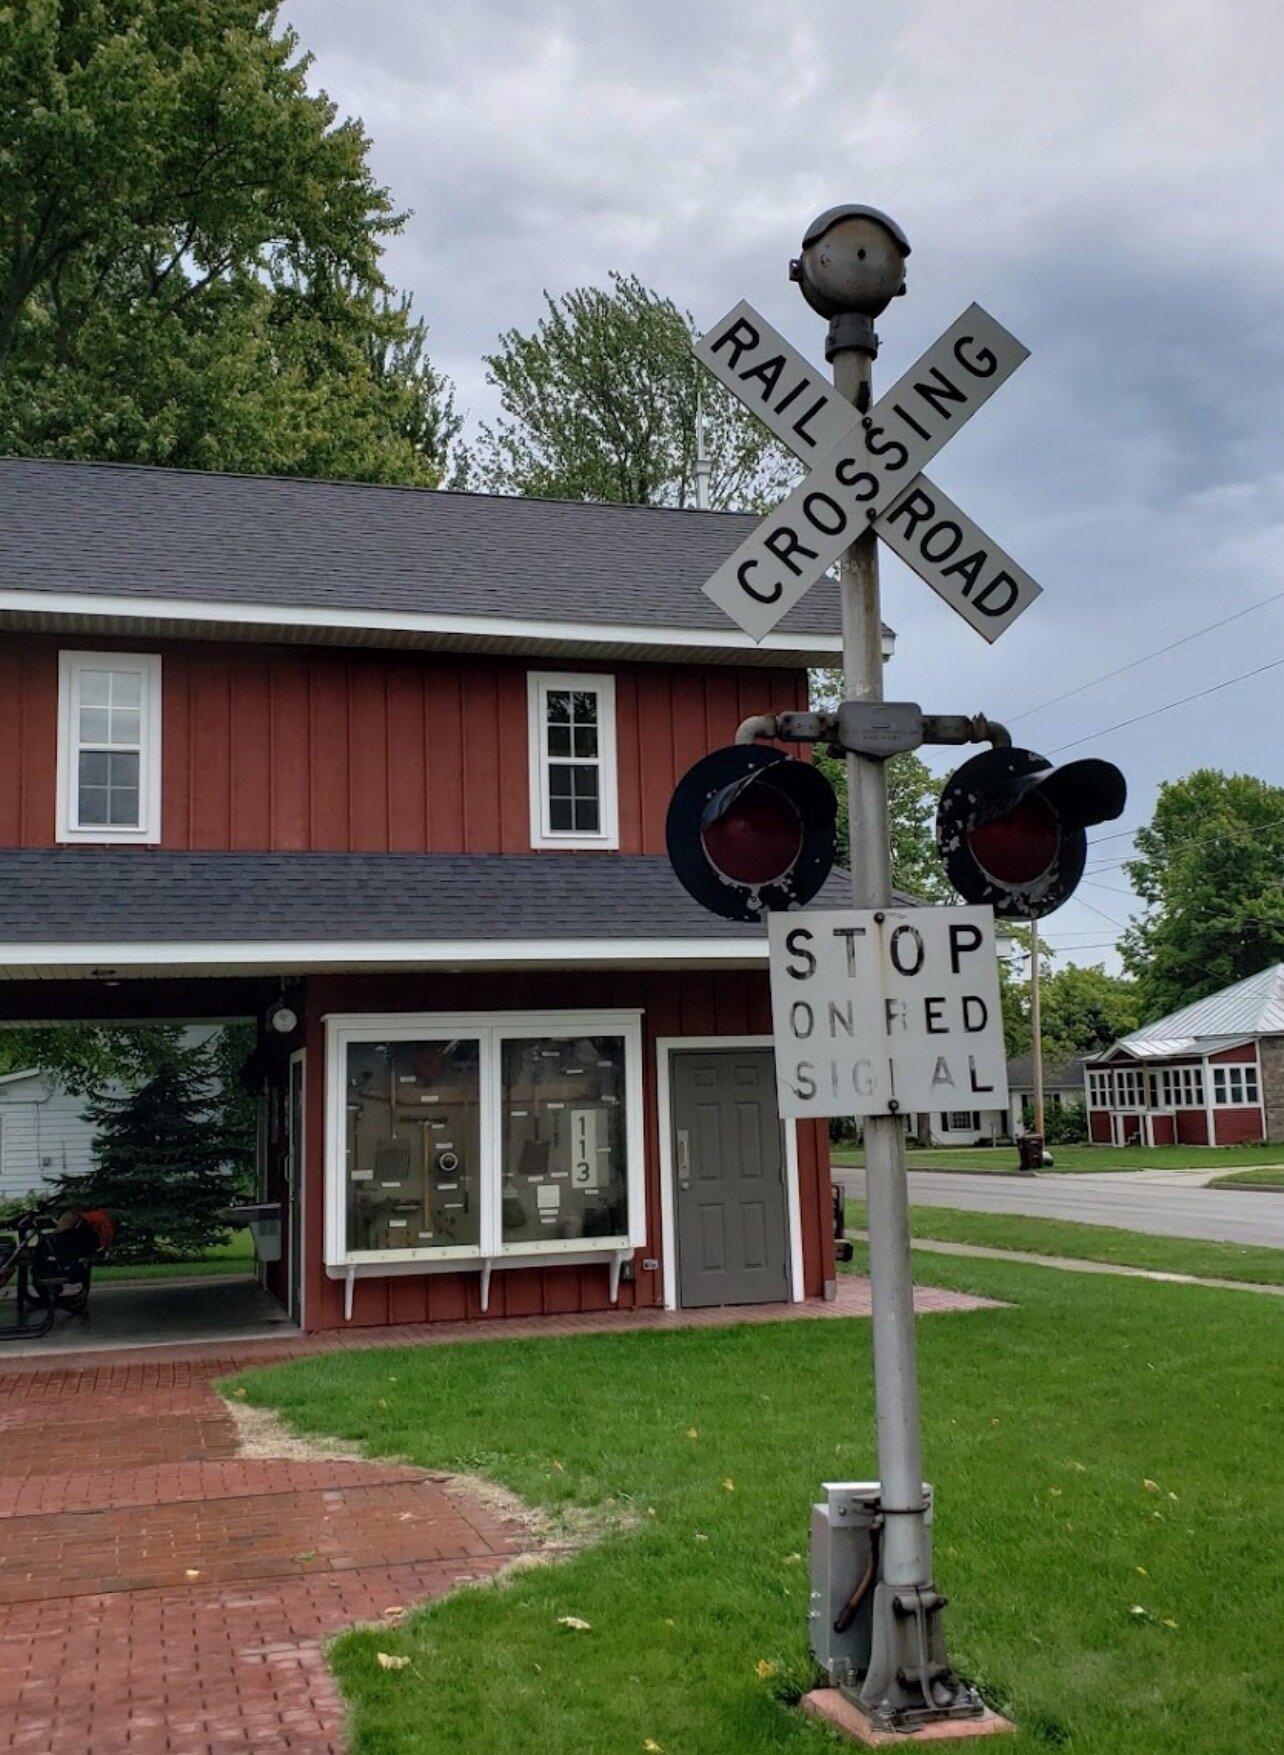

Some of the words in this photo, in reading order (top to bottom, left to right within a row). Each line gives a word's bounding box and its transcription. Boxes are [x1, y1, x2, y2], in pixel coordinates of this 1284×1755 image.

[711, 317, 828, 447] RAIL
[886, 488, 1019, 616] ROAD
[737, 336, 998, 604] CROSSING
[786, 924, 983, 980] STOP
[790, 1001, 853, 1038] ON
